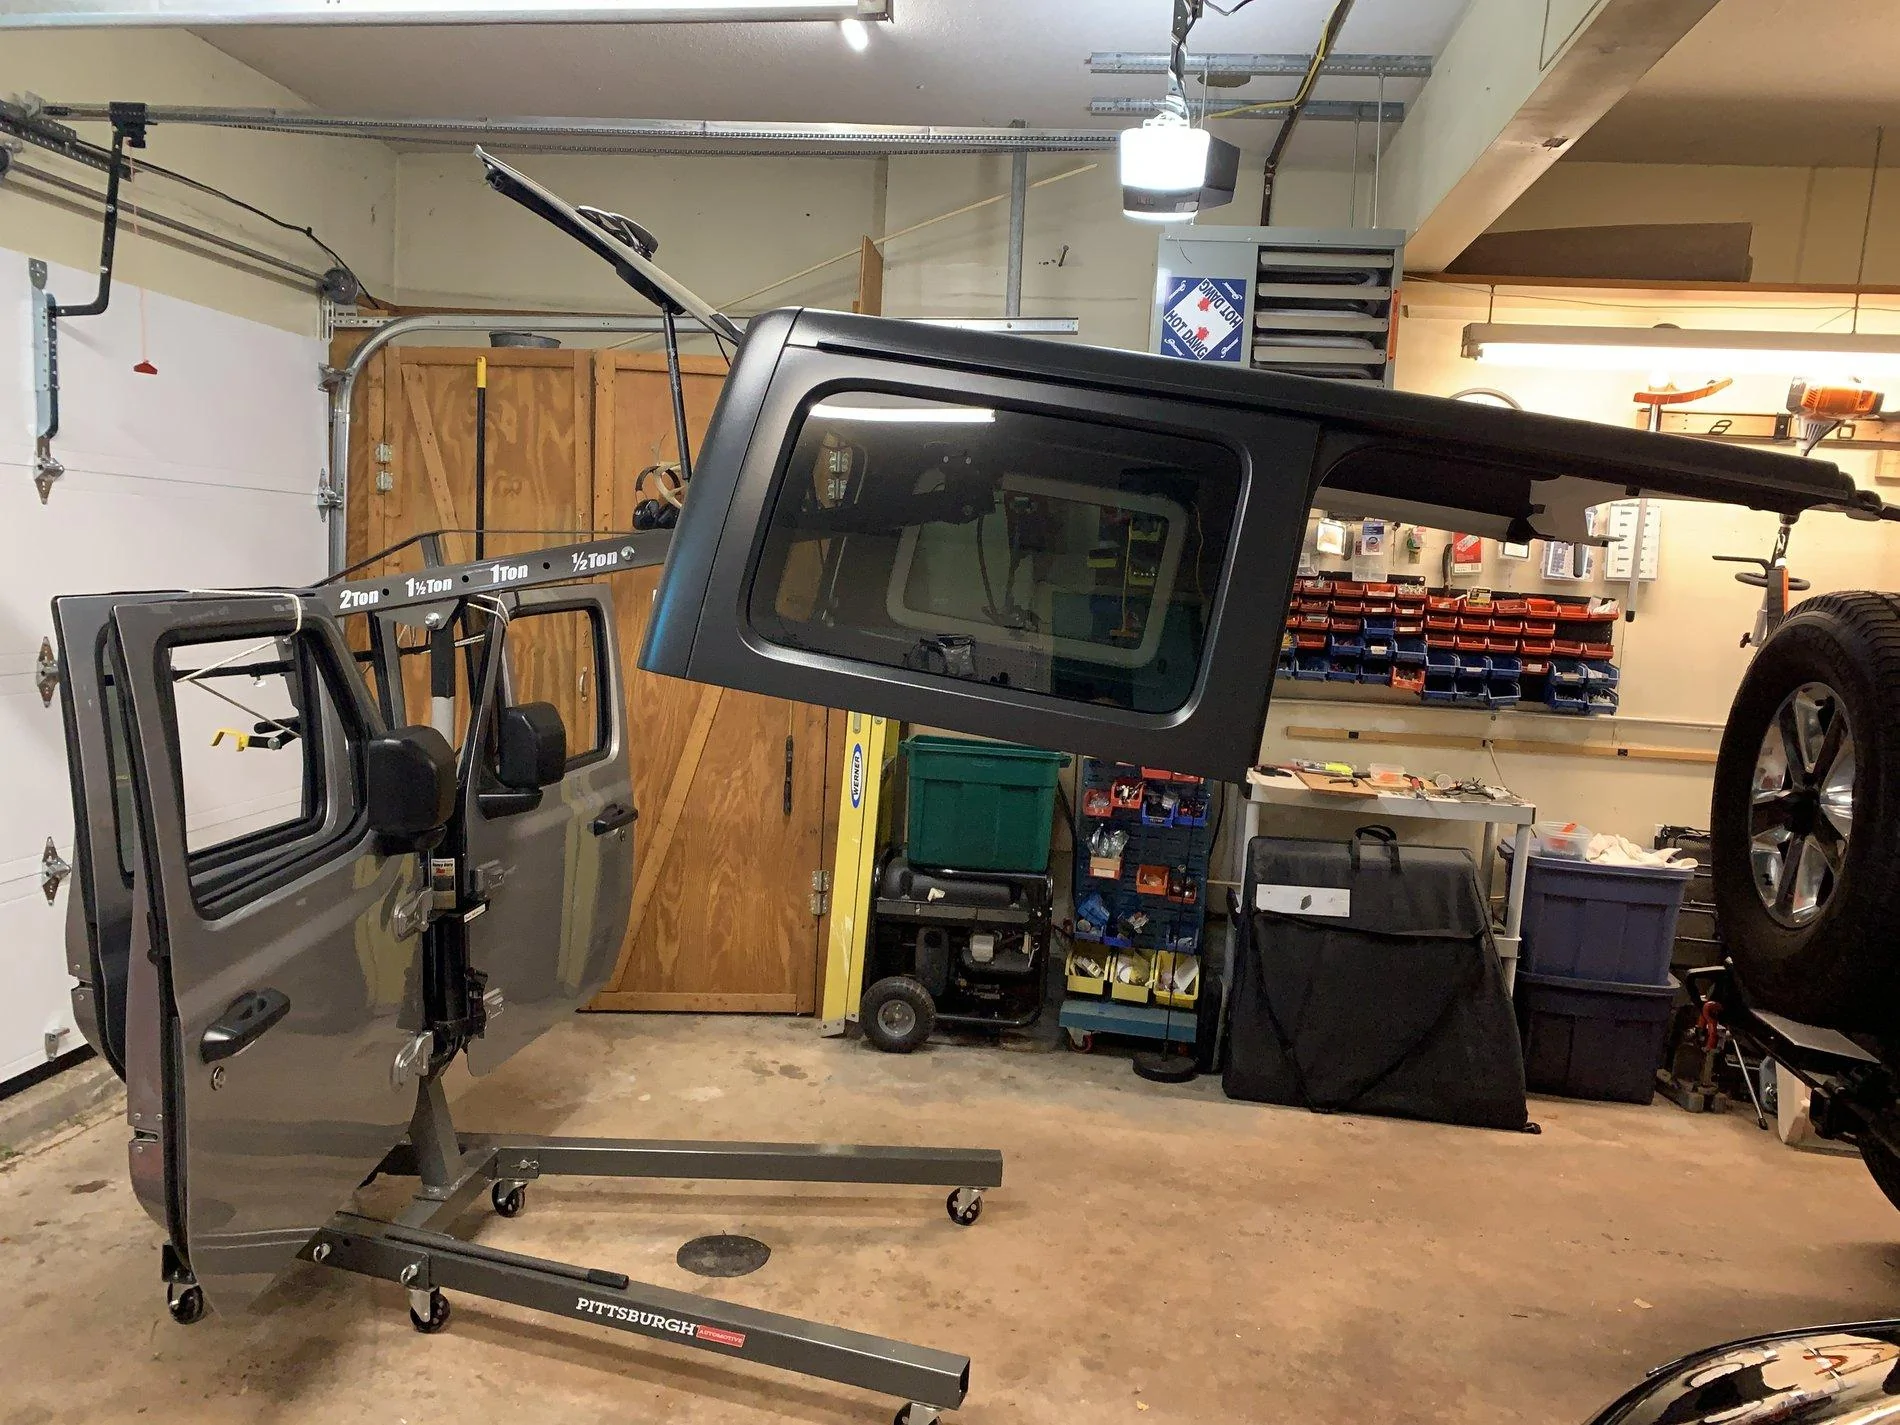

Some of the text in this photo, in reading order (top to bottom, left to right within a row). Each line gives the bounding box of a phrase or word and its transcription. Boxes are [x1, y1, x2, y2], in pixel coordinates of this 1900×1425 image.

[1198, 279, 1226, 310] DAWG
[1219, 305, 1242, 328] HOT
[1165, 309, 1188, 332] HOT
[1181, 328, 1209, 359] DAWG
[490, 562, 529, 584] 1Ton
[339, 588, 379, 610] 2Ton
[852, 755, 861, 796] WERNER
[575, 1297, 744, 1344] PITTSBURGH AUTOMOTIVE
